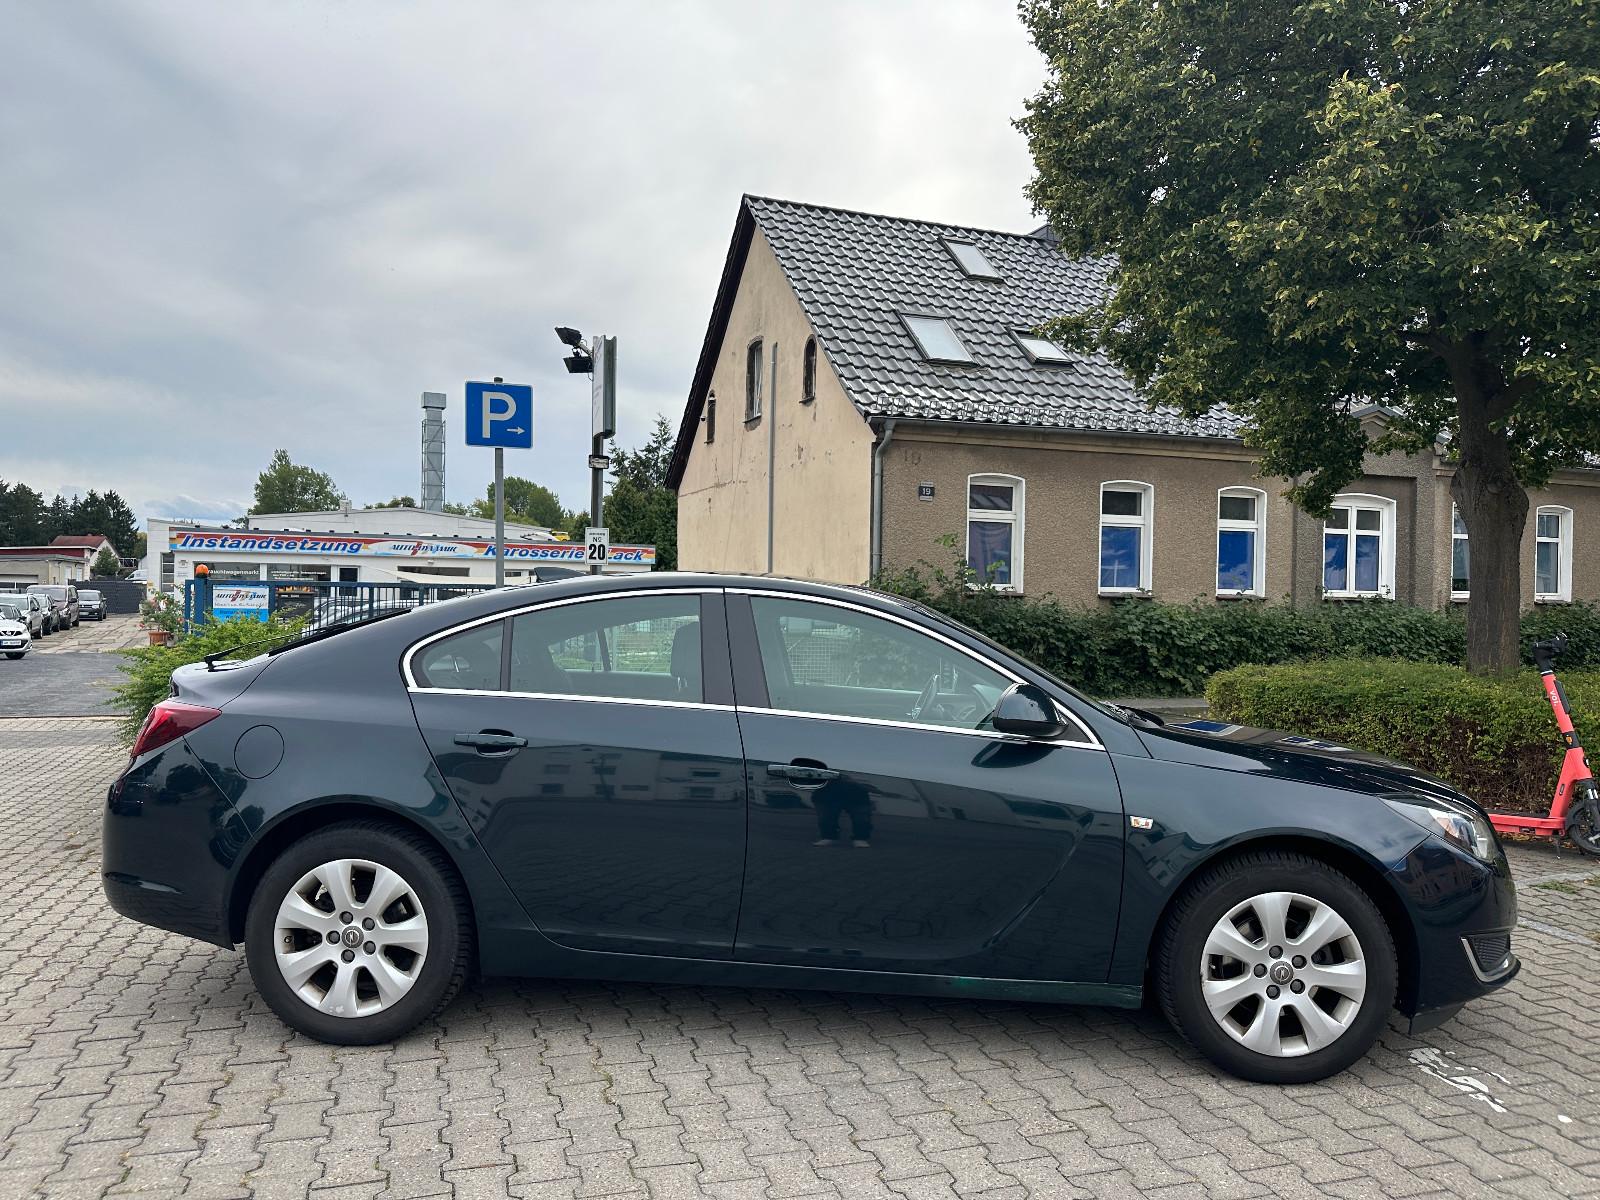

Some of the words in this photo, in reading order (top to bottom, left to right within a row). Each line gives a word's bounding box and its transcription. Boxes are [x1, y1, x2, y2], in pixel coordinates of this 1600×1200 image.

[482, 391, 517, 438] P
[922, 487, 931, 495] 19
[181, 535, 363, 553] Instandsetzung
[588, 543, 606, 560] 20
[607, 550, 644, 561] ack
